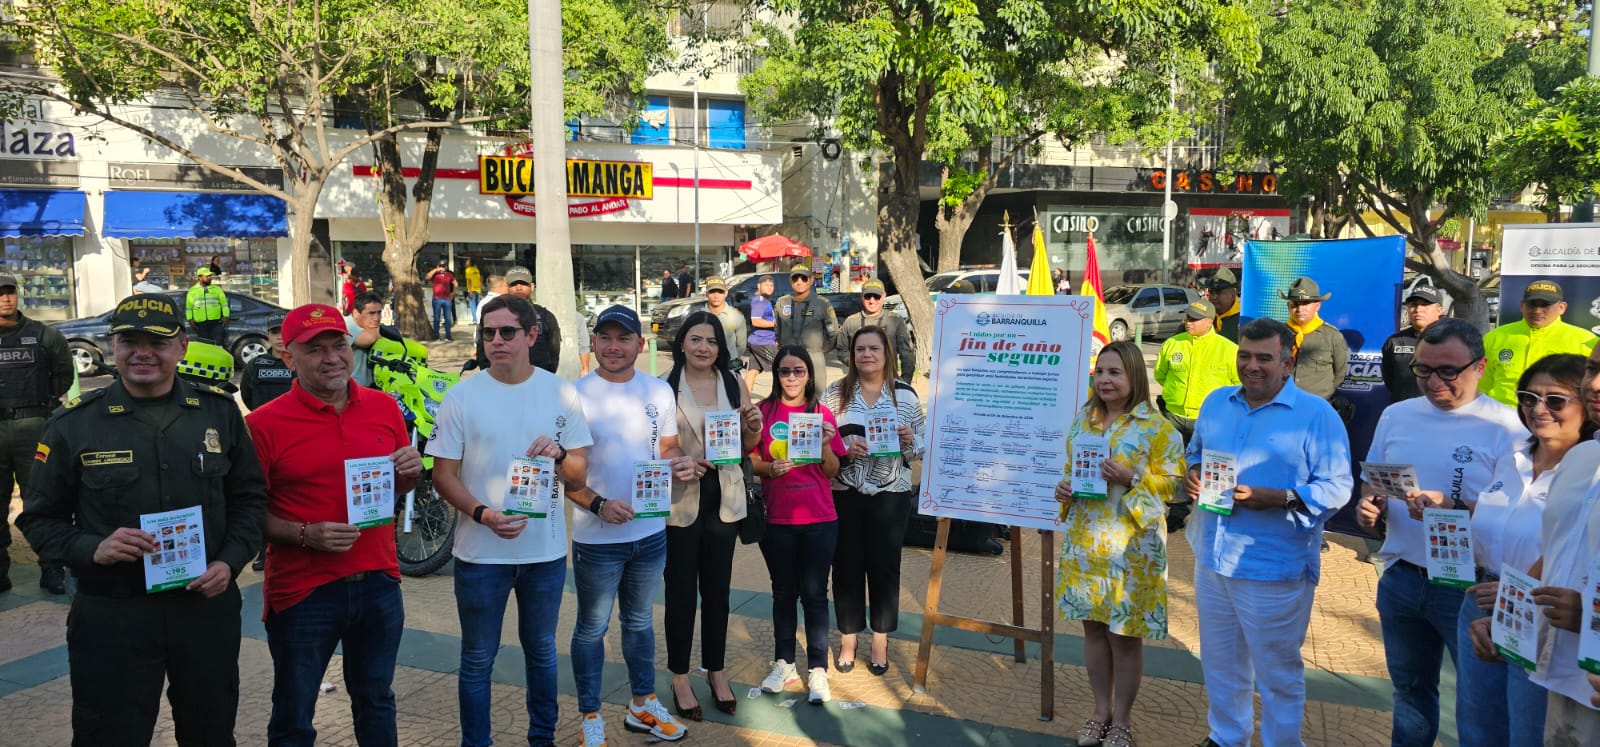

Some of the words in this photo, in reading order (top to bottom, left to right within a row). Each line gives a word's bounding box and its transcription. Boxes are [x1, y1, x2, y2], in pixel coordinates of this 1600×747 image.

[485, 159, 644, 195] BUCMANGA
[1151, 170, 1277, 192] CASNO
[513, 203, 535, 213] DIFER
[602, 199, 626, 211] ANDAR
[1543, 247, 1581, 255] ALCALDÍA
[117, 298, 173, 315] POLICIA
[991, 318, 1047, 326] BARRANQUILLA
[960, 338, 987, 351] fin
[992, 339, 1016, 351] de
[1022, 340, 1062, 353] año
[987, 353, 1060, 367] seguro
[1451, 467, 1464, 501] QUILLA
[172, 567, 186, 575] 195
